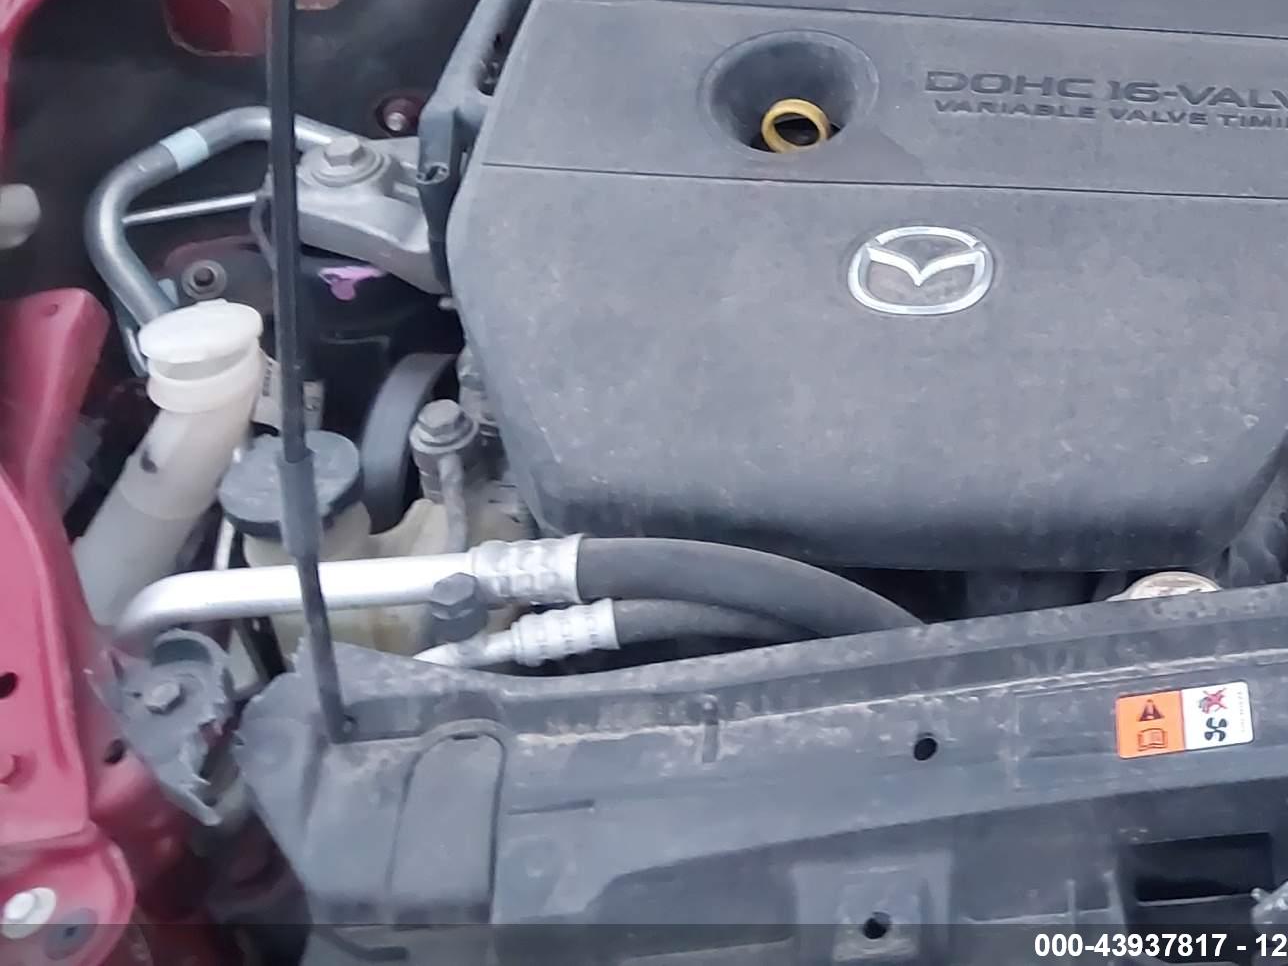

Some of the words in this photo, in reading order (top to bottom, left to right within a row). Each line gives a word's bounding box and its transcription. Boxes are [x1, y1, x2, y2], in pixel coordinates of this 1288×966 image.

[924, 70, 1097, 99] DOHC
[934, 99, 1097, 119] VARIABLE
[1109, 107, 1209, 126] VALVE
